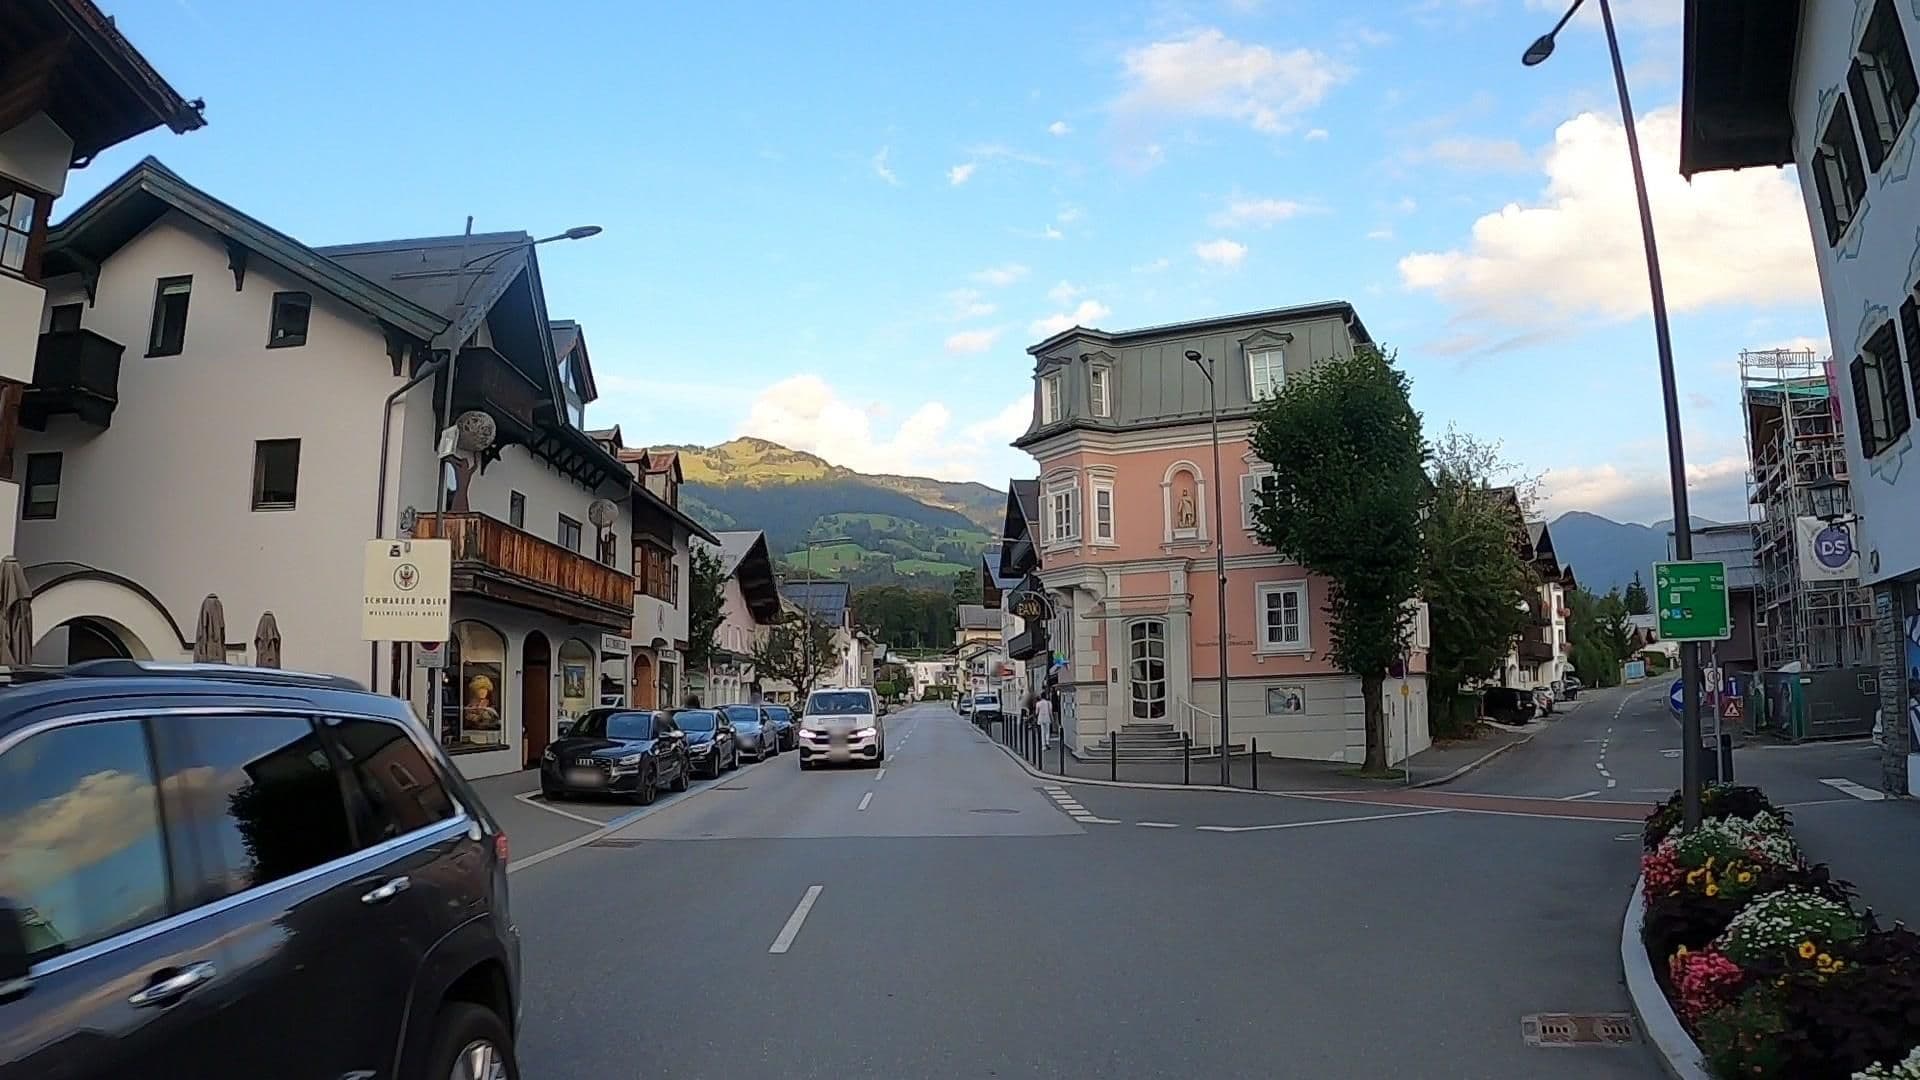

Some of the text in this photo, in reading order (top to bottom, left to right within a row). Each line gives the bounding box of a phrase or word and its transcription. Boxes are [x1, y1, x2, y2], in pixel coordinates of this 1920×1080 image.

[1821, 540, 1846, 556] DS
[364, 596, 447, 606] SCHWARZER ADLER
